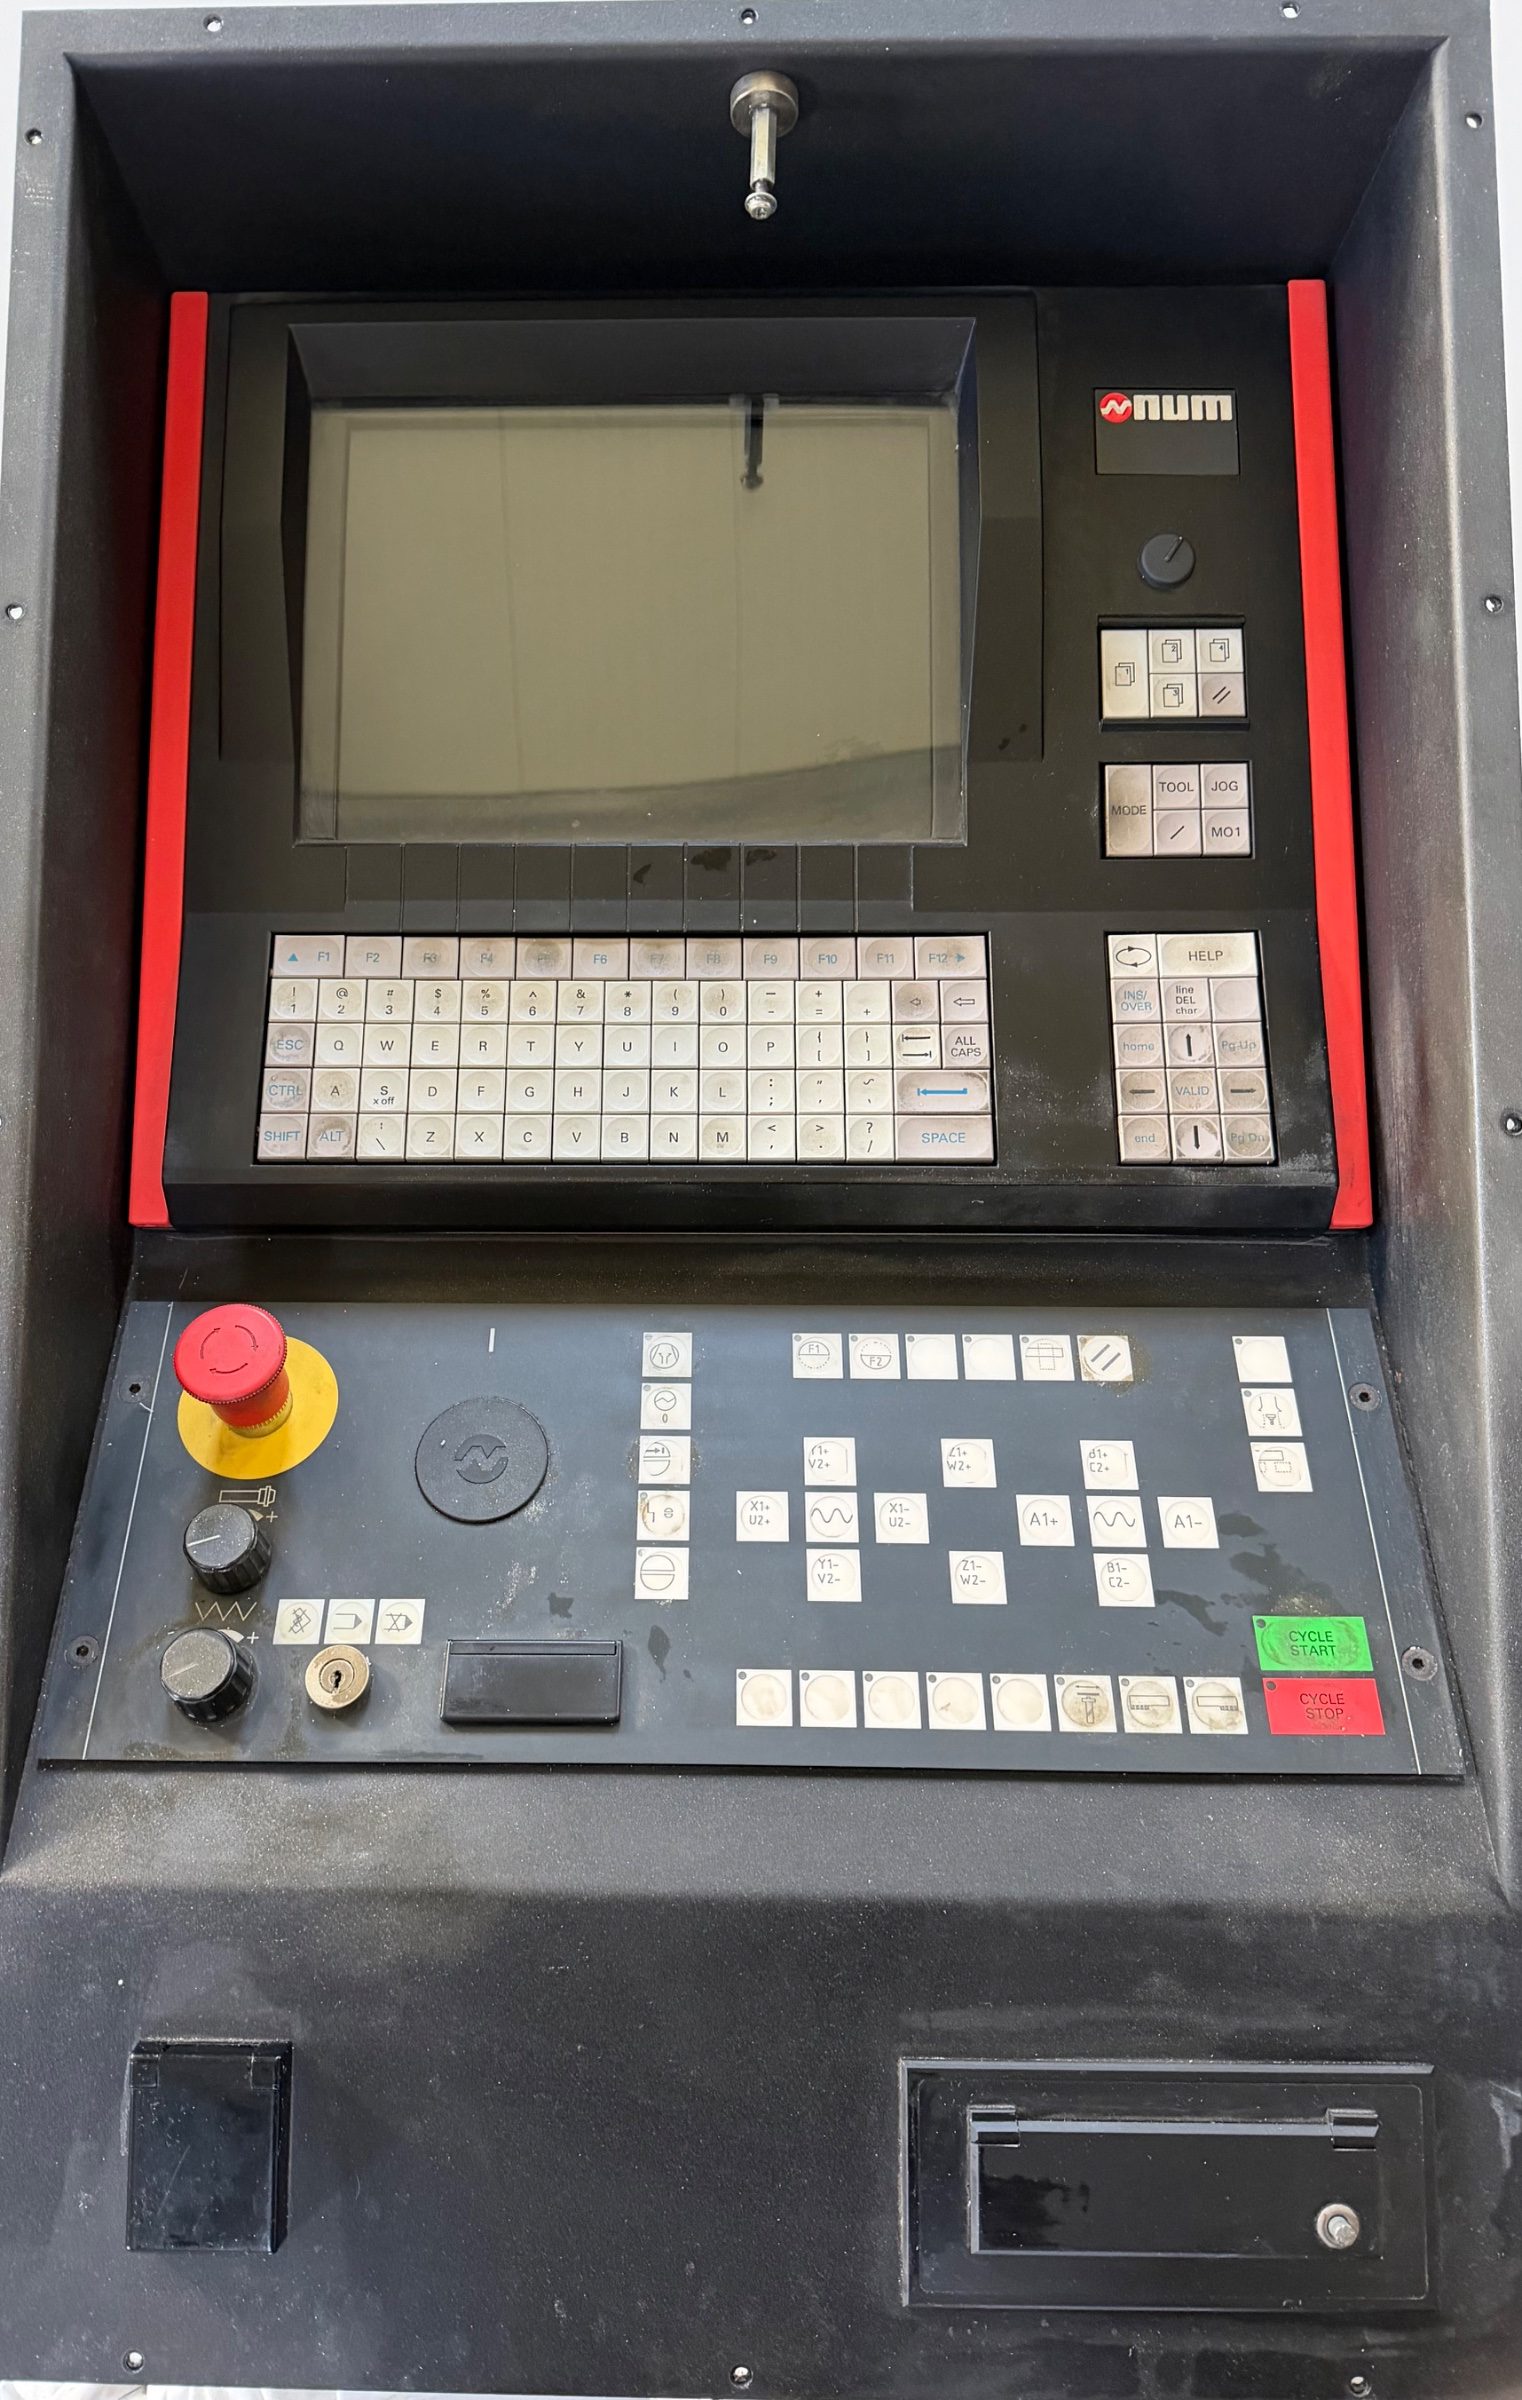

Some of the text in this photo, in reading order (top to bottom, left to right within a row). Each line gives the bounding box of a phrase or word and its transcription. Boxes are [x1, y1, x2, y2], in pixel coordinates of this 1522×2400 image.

[1132, 394, 1233, 421] num
[1158, 781, 1195, 793] TOOL
[1210, 780, 1239, 792] JOG
[1110, 804, 1148, 817] MODE
[317, 951, 331, 963] F1
[365, 952, 381, 963] F2
[423, 952, 438, 964] F3
[480, 952, 494, 964] F4
[593, 954, 608, 965] F6
[763, 953, 778, 965] F9
[817, 953, 838, 965] F10
[876, 953, 895, 965] F11
[928, 953, 949, 964] F12
[1188, 950, 1224, 962] HELP
[1123, 990, 1148, 1001] INS/
[1175, 985, 1195, 995] line
[1120, 1001, 1153, 1012] OVER
[1175, 996, 1197, 1005] DEL
[289, 1003, 297, 1014] 1
[336, 1004, 346, 1015] 2
[385, 1005, 393, 1016] 3
[433, 1005, 441, 1016] 4
[480, 1005, 489, 1016] 5
[528, 1005, 537, 1016] 6
[576, 1005, 585, 1017] 7
[623, 1006, 632, 1017] 8
[671, 1006, 680, 1017] 9
[1175, 1006, 1198, 1015] char
[275, 1039, 304, 1051] ESC
[333, 1039, 345, 1052] Q
[379, 1039, 394, 1052] W
[431, 1039, 439, 1052] E
[479, 1039, 488, 1052] R
[526, 1039, 536, 1052] T
[574, 1039, 584, 1052] Y
[622, 1040, 633, 1052] U
[954, 1035, 977, 1046] ALL
[1122, 1041, 1155, 1051] home
[718, 1041, 729, 1053] O
[766, 1041, 776, 1053] P
[950, 1047, 982, 1058] CAPS
[267, 1084, 303, 1097] CTRL
[329, 1084, 341, 1098] A
[380, 1084, 389, 1098] S
[427, 1084, 438, 1098] D
[477, 1084, 485, 1098] F
[523, 1084, 535, 1098] G
[573, 1084, 583, 1098] H
[621, 1086, 631, 1098] J
[670, 1086, 679, 1098] K
[719, 1086, 727, 1098] L
[1175, 1085, 1210, 1097] VALID
[381, 1096, 395, 1106] off
[866, 1121, 873, 1134] ?
[263, 1130, 301, 1142] SHIFT
[318, 1130, 345, 1142] ALT
[426, 1131, 435, 1144] Z
[474, 1131, 484, 1144] X
[522, 1131, 532, 1144] C
[571, 1131, 582, 1144] V
[619, 1131, 629, 1144] B
[668, 1131, 678, 1144] N
[716, 1131, 729, 1144] M
[920, 1132, 967, 1144] SPACE
[1134, 1133, 1156, 1143] end
[808, 1343, 820, 1354] F1
[869, 1356, 883, 1367] F2
[808, 1458, 831, 1470] V2+
[749, 1500, 770, 1512] X1+
[888, 1502, 911, 1514] X1-
[748, 1515, 771, 1526] U2+
[888, 1517, 911, 1528] U2-
[1029, 1512, 1059, 1527] A1+
[1174, 1514, 1203, 1529] A1-
[818, 1558, 840, 1570] Y1-
[961, 1559, 983, 1571] Z1-
[1107, 1561, 1127, 1573] B1-
[817, 1573, 841, 1585] V2-
[960, 1574, 987, 1586] W2-
[1108, 1576, 1130, 1588] C2-
[1288, 1630, 1334, 1642] CYCLE
[1290, 1645, 1337, 1657] START
[1299, 1692, 1345, 1705] CYCLE
[1305, 1707, 1344, 1720] STOP
